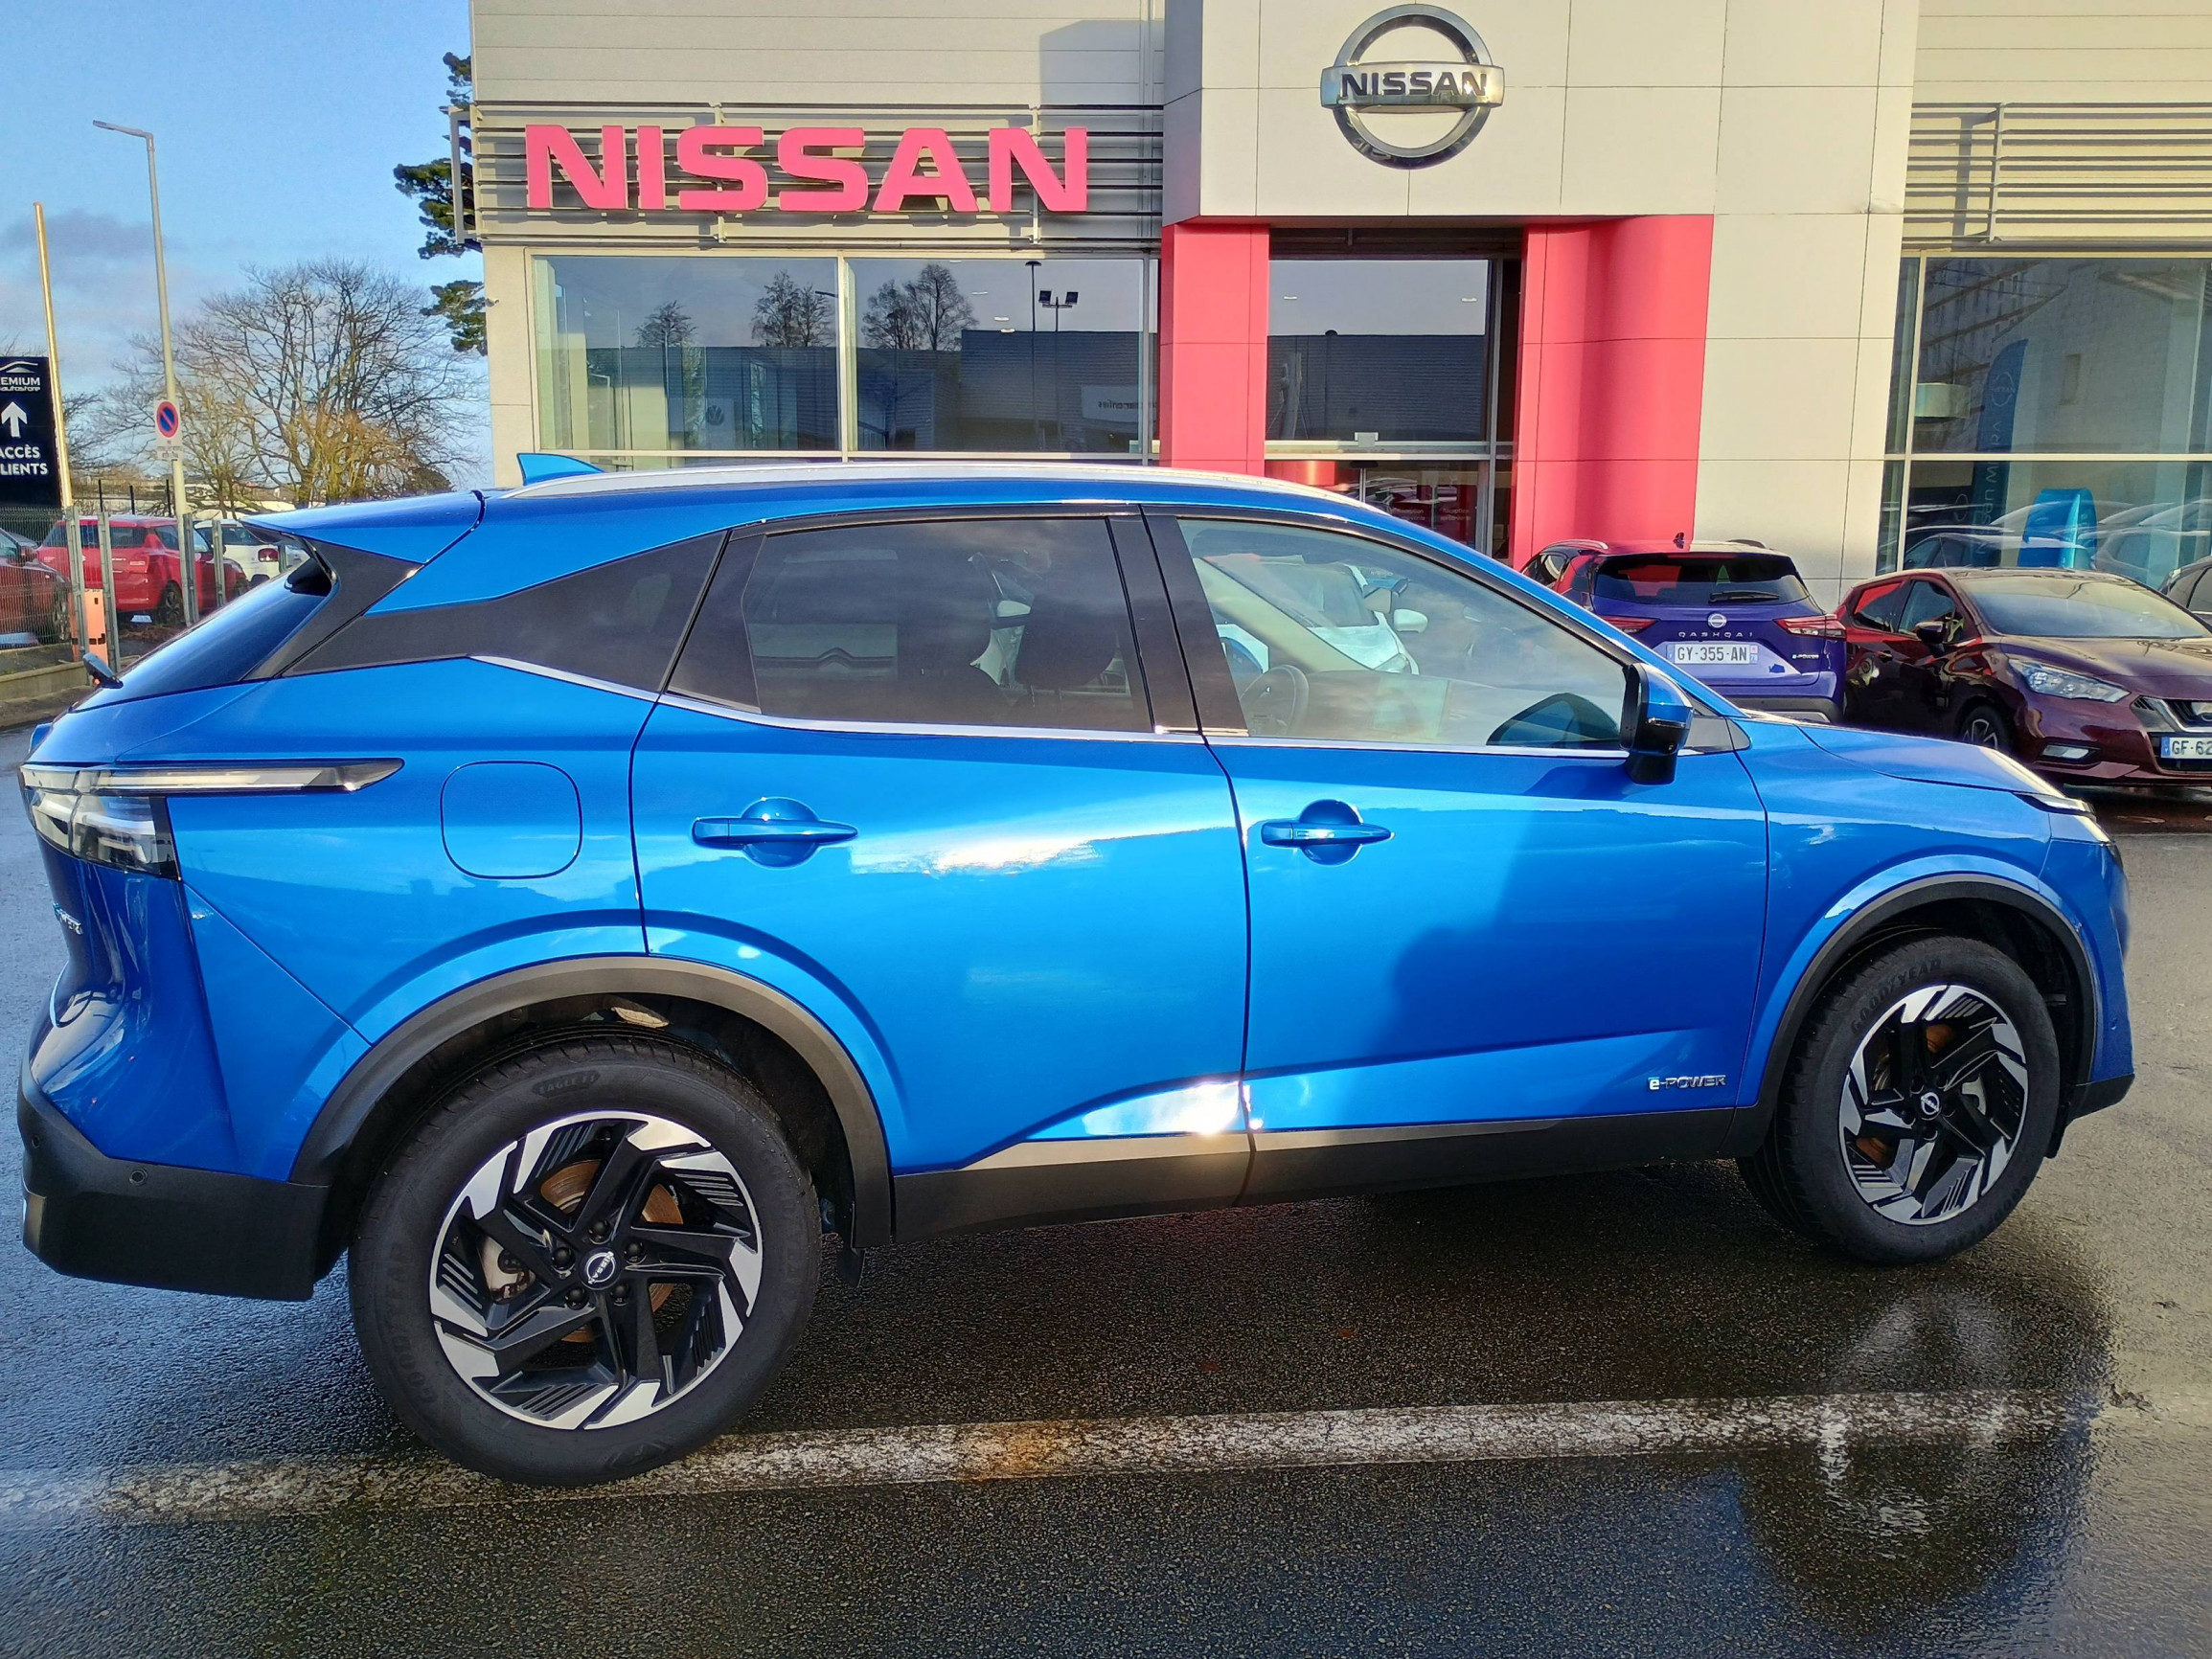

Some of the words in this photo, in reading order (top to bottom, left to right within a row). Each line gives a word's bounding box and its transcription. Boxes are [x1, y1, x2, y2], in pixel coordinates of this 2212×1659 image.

[1341, 72, 1488, 97] NISSAN
[526, 125, 1088, 212] NISSAN
[0, 443, 40, 459] ACCÈS
[1677, 647, 1747, 661] GY-355-AN
[1648, 1075, 1726, 1091] e-POWER
[587, 1250, 614, 1284] NISSAN
